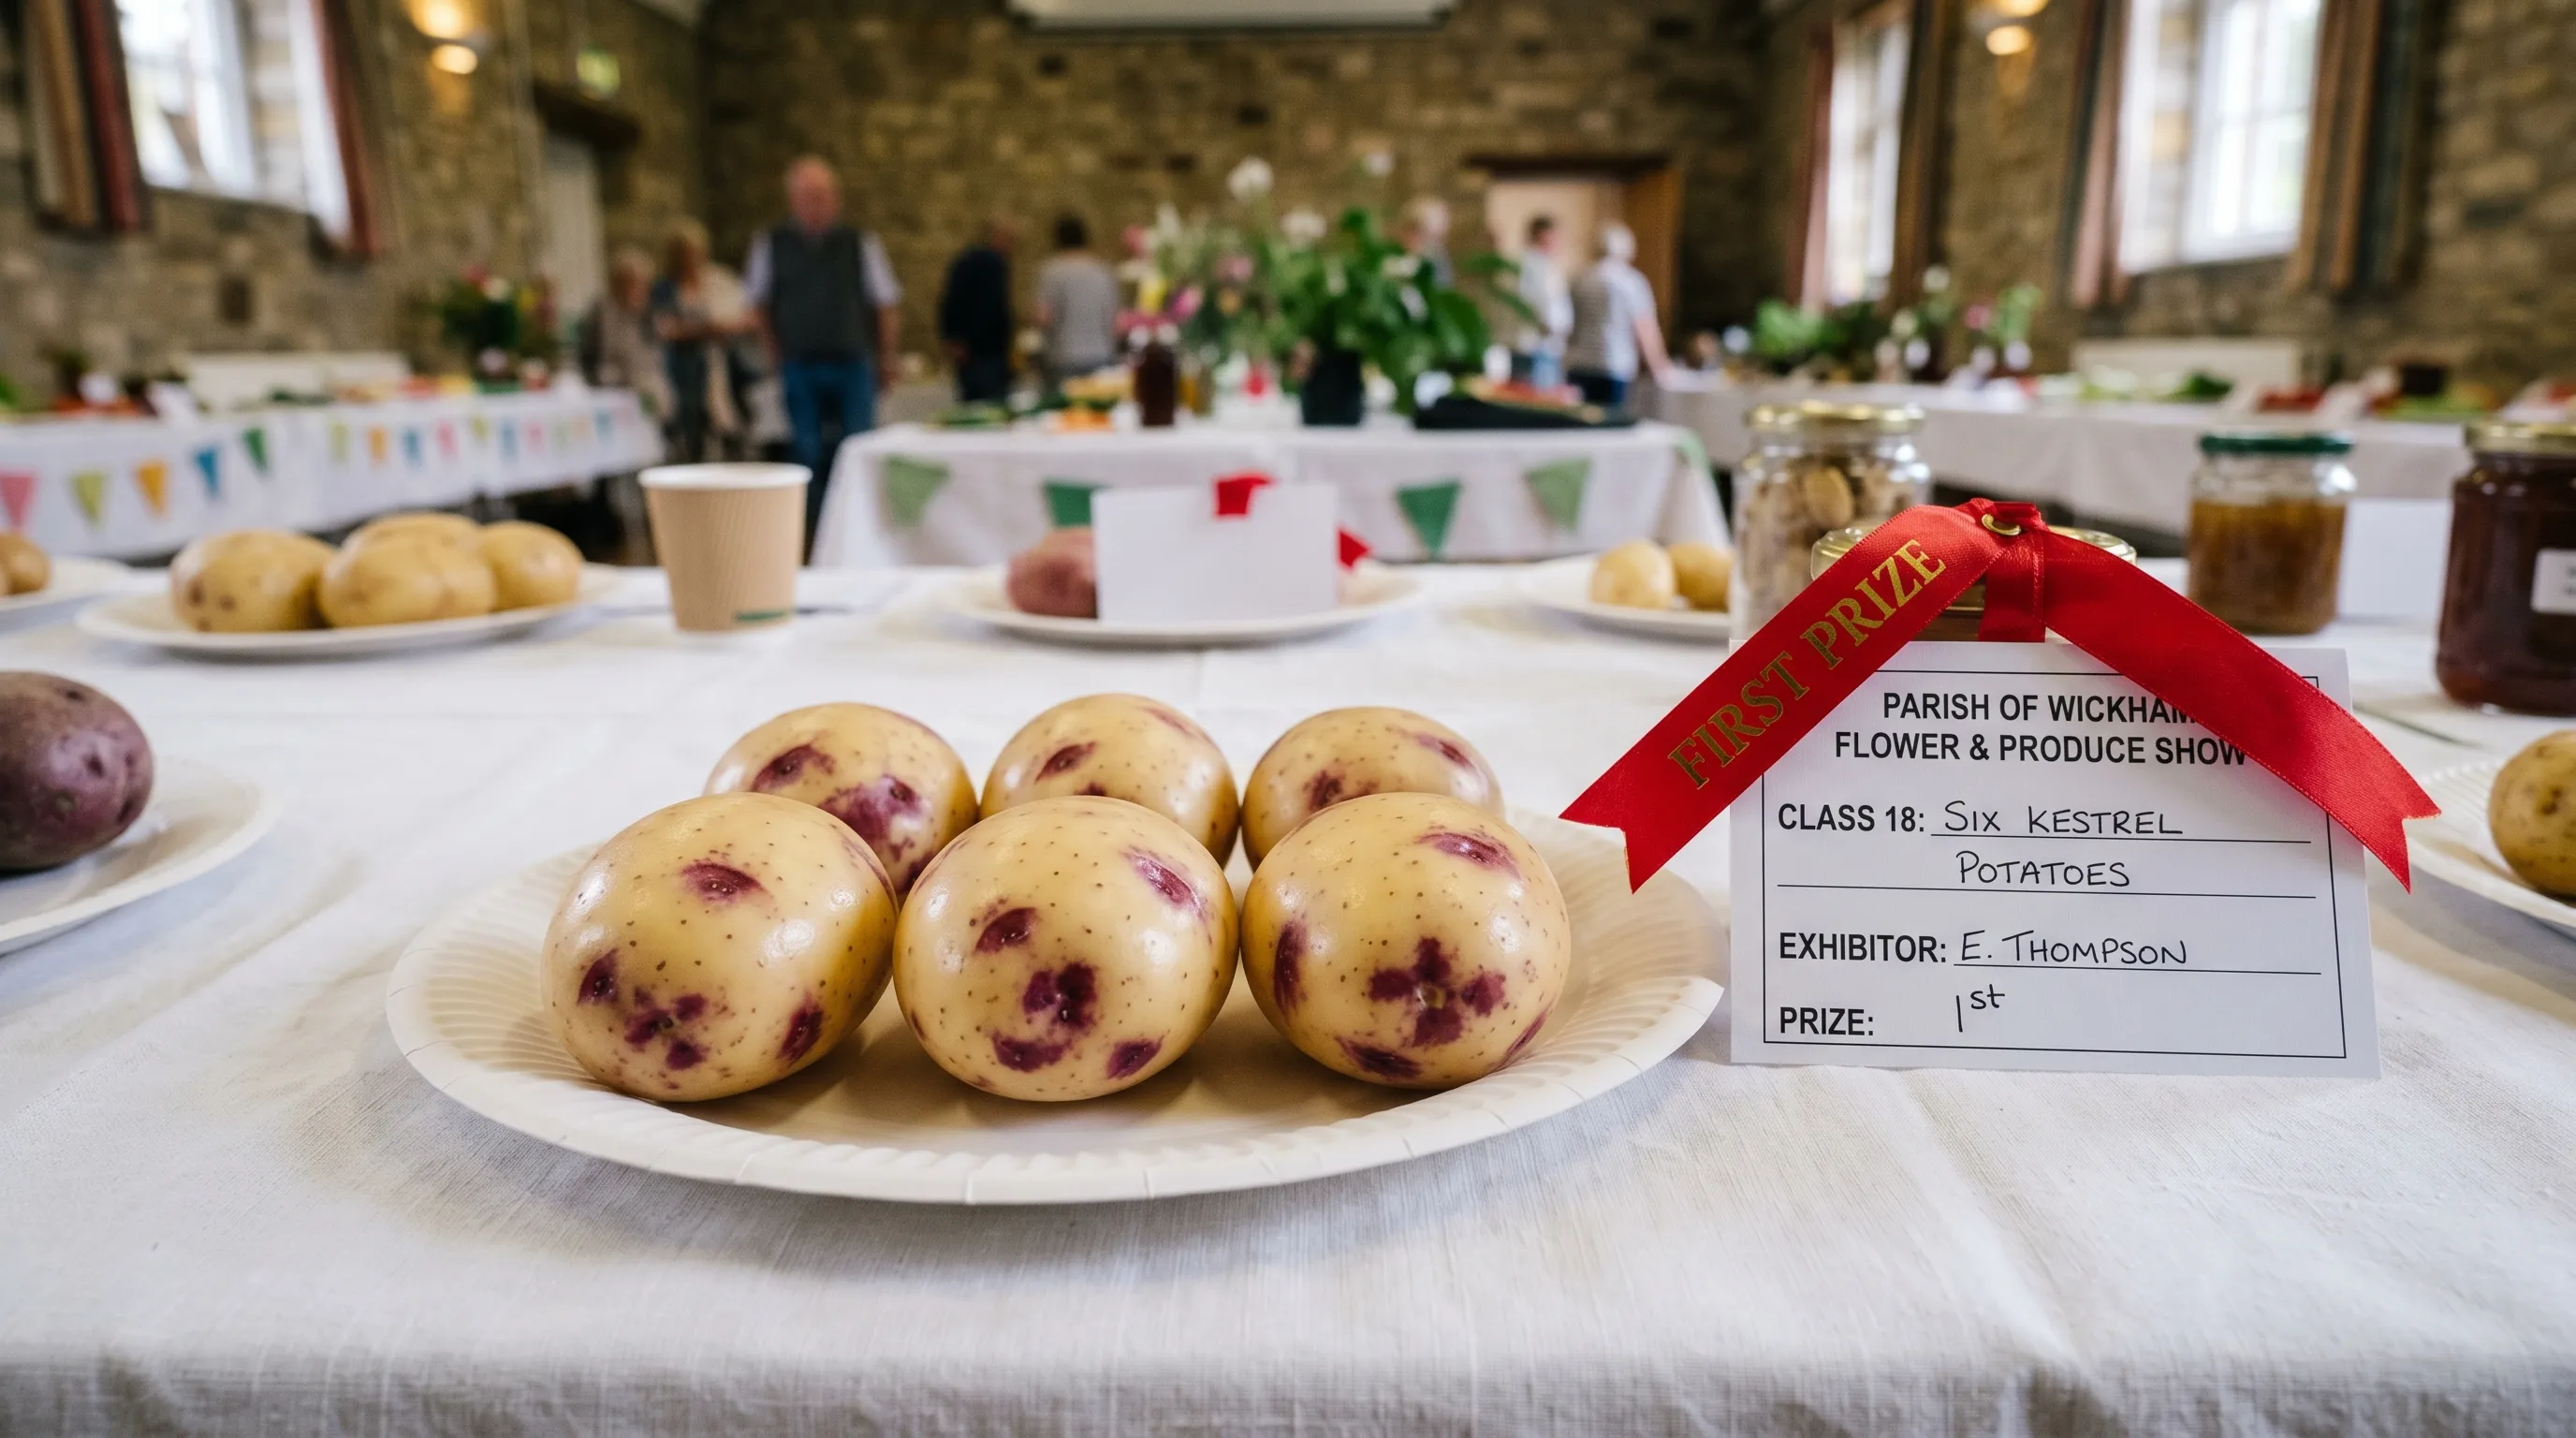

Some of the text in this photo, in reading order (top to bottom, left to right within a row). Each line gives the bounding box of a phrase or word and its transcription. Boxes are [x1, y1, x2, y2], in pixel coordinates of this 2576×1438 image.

[1667, 539, 1947, 789] FIRST PRIZE
[1883, 692, 1989, 721] PARISH
[1999, 694, 2039, 721] OF
[1836, 731, 1960, 760] FLOWER
[1968, 733, 1991, 761] &
[1999, 734, 2145, 763] PRODUCE
[1778, 800, 2185, 836] CLASS 18: SIX KESTREL
[1955, 850, 2130, 888] POTATOES
[1779, 929, 2188, 965] EXHIBITOR: E. THOMPSON
[1778, 983, 2006, 1037] PRIZE: 1st
